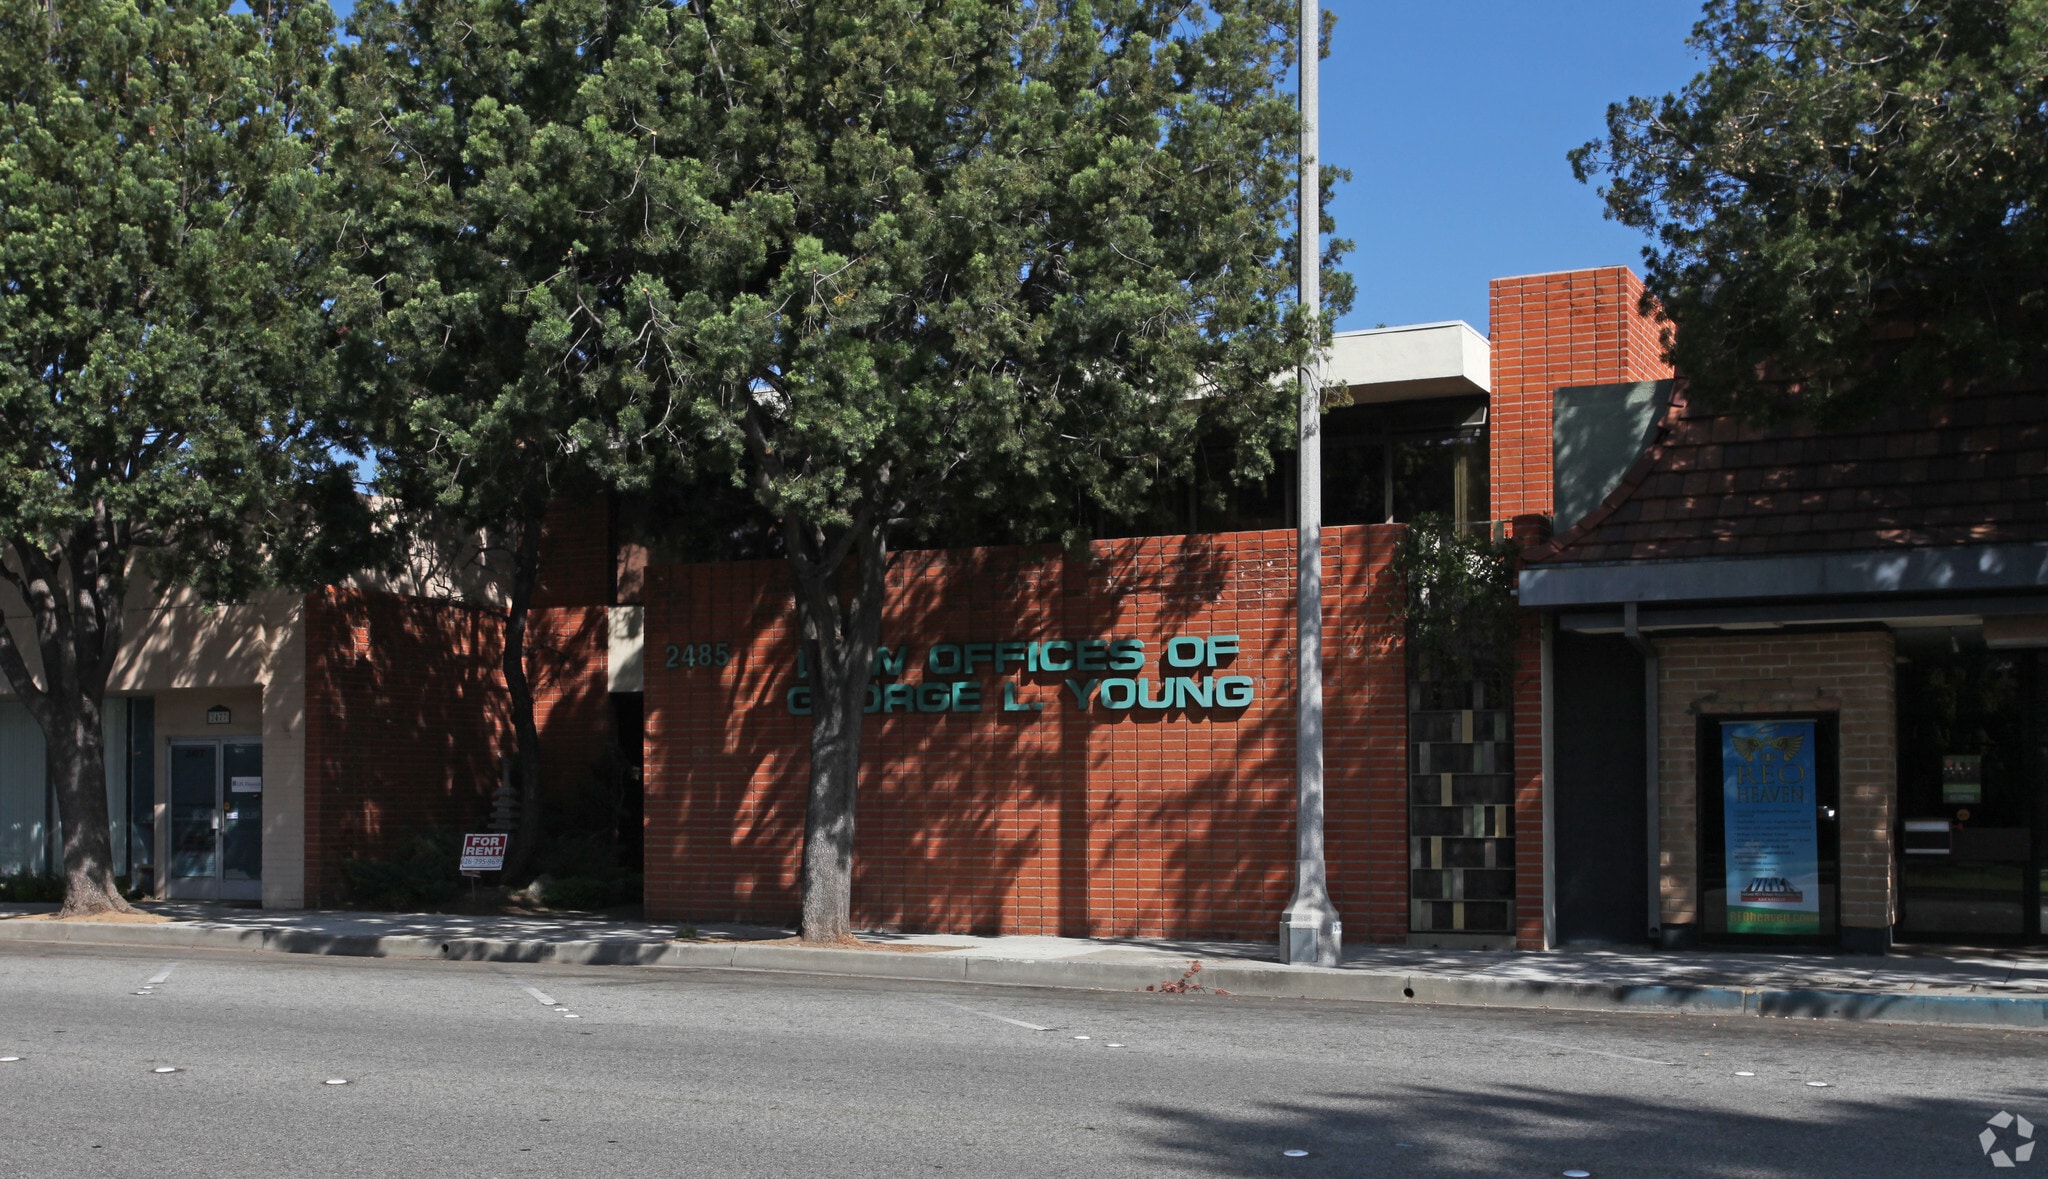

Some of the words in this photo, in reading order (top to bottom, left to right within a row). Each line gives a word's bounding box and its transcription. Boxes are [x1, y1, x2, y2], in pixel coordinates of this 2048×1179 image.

[665, 643, 730, 668] 2485
[929, 638, 1146, 675] OFFICES
[1167, 634, 1240, 668] OF
[1004, 680, 1044, 712] L.
[1071, 675, 1255, 711] YOUNG
[1736, 764, 1805, 784] REO
[1736, 786, 1804, 803] HEAVEN
[466, 846, 502, 856] RENT
[471, 837, 499, 846] FOR
